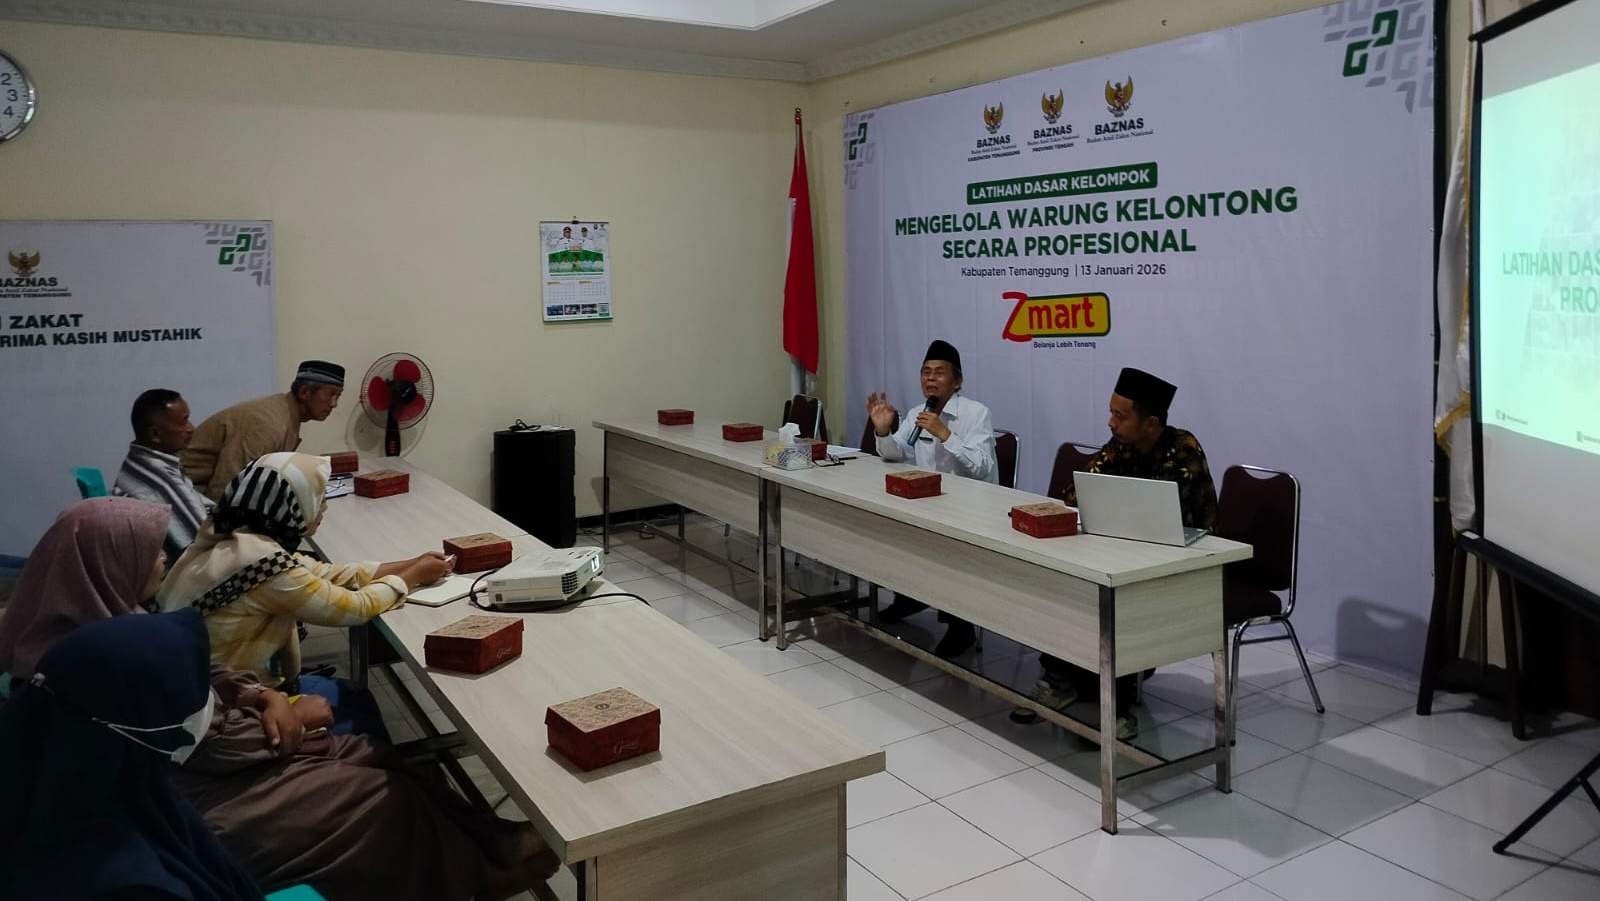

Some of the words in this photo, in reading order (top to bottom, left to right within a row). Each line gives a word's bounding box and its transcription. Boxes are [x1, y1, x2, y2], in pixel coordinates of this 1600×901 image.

[7, 88, 18, 102] 3
[3, 105, 14, 118] 4
[1033, 124, 1073, 139] BAZNAS
[1095, 117, 1145, 135] BAZNAS
[977, 134, 1011, 148] BAZNAS
[972, 184, 1022, 200] LATIHAN
[1024, 178, 1068, 194] DASAR
[1071, 169, 1151, 190] KELOMPOK
[895, 210, 1002, 236] MENGELOLA
[1006, 201, 1109, 229] WARUNG
[1116, 186, 1298, 223] KELONTONG
[942, 236, 1019, 259] SECARA
[1024, 228, 1197, 257] PROFESIONAL
[961, 266, 1006, 278] Kabupaten
[1009, 265, 1070, 278] Temanggung
[1094, 264, 1134, 276] Januari
[1137, 264, 1167, 276] 2026
[1503, 250, 1563, 276] LATIHAN
[1560, 285, 1600, 313] PRO
[9, 313, 83, 329] ZAKAT
[1002, 291, 1095, 343] Zmart
[53, 331, 108, 345] KASIH
[113, 328, 202, 344] MUSTAHIK
[1033, 341, 1055, 349] Belanja
[1073, 341, 1096, 349] Tenang
